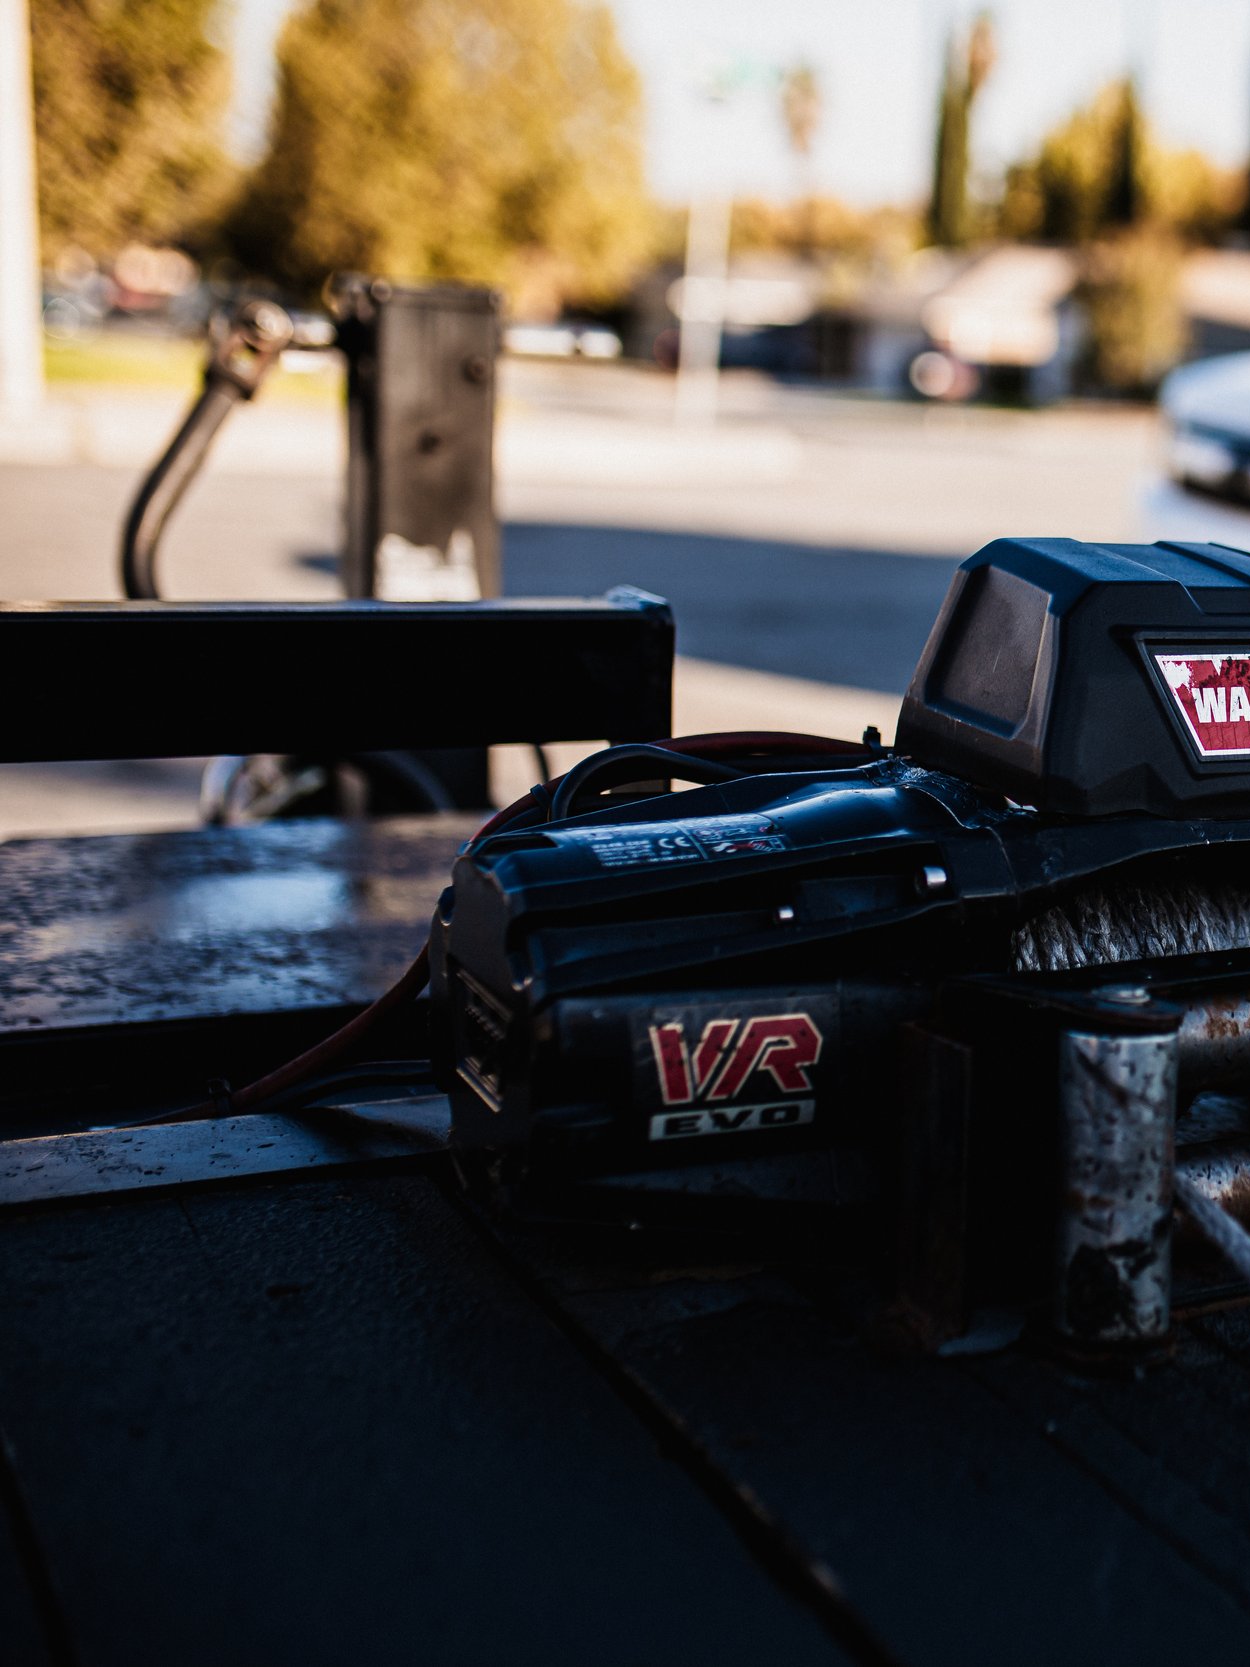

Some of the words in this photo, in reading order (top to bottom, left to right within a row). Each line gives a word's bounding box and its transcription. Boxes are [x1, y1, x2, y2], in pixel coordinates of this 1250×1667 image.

[659, 836, 692, 849] CE
[649, 1012, 823, 1105] VR
[665, 1106, 799, 1135] EVO
